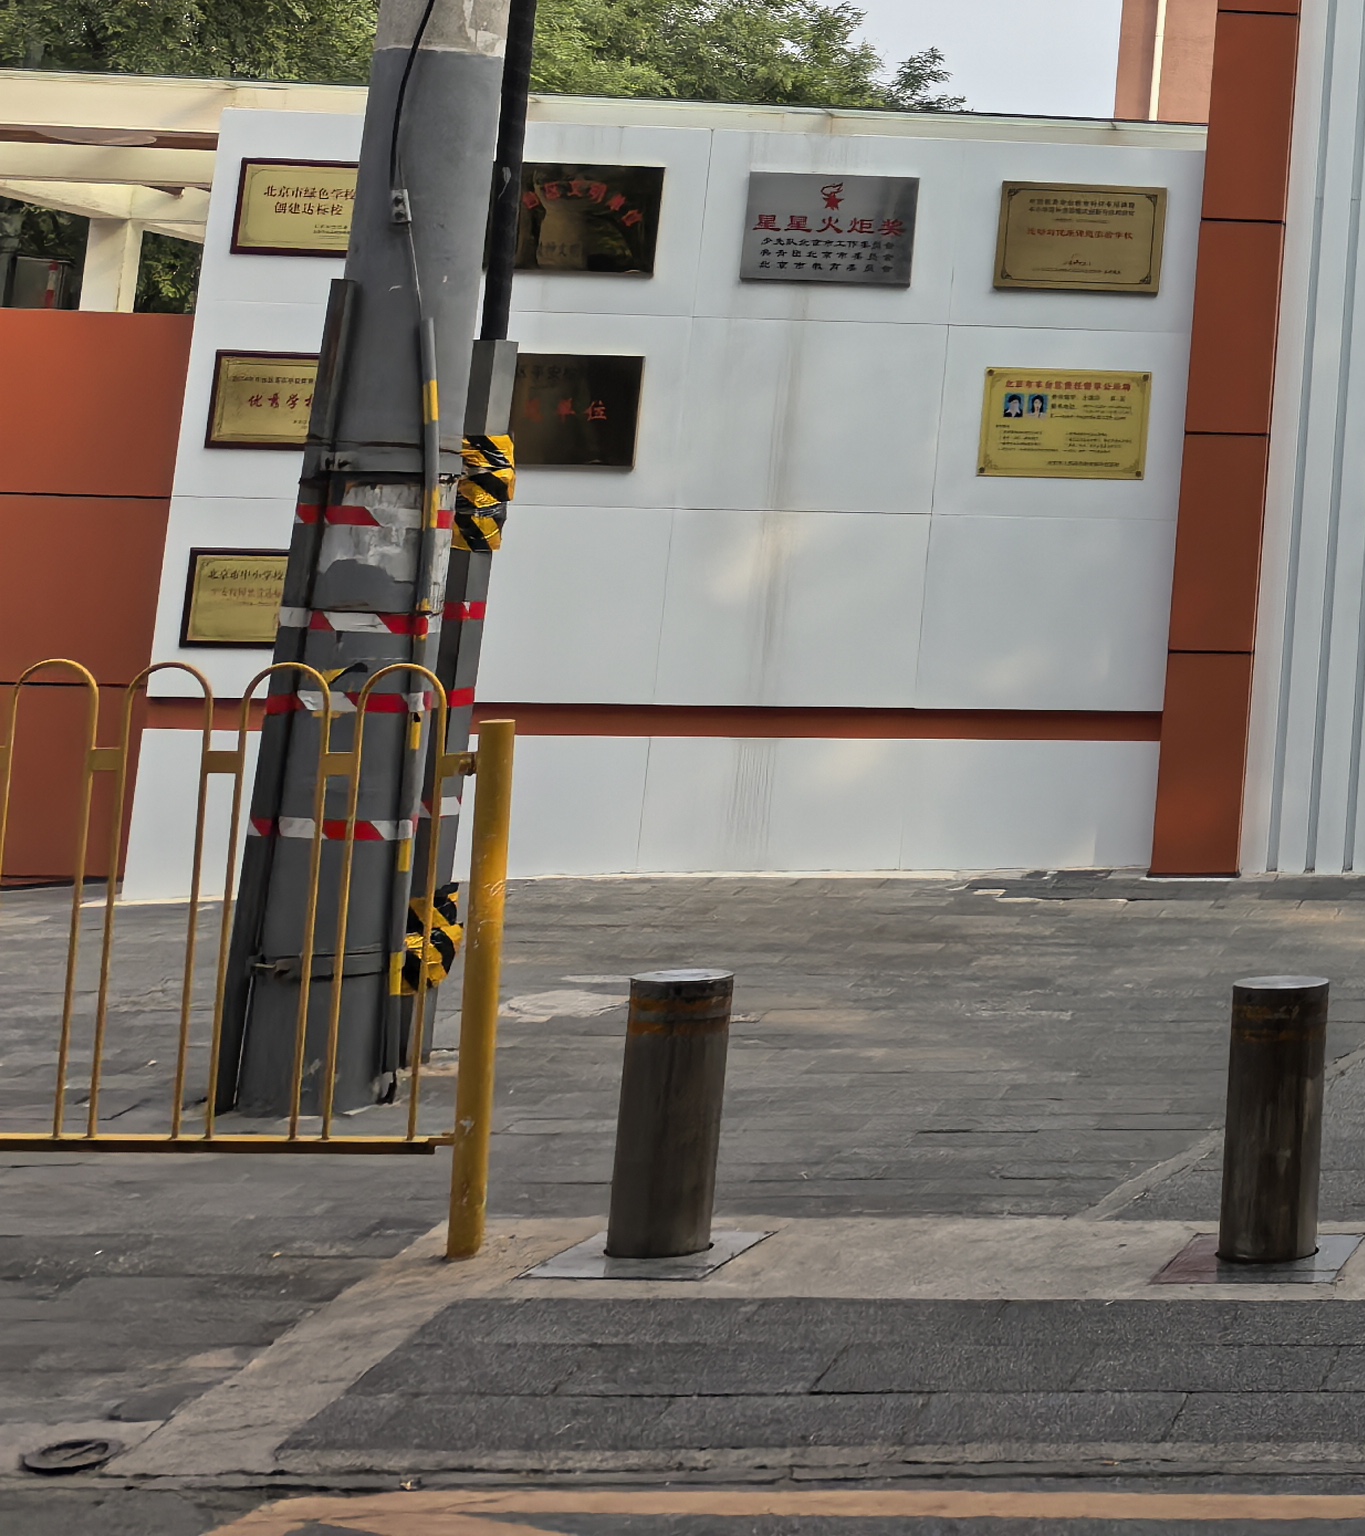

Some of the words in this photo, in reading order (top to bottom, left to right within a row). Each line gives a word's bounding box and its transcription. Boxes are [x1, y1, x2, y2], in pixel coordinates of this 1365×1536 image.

[752, 214, 907, 237] 星星火炬奖
